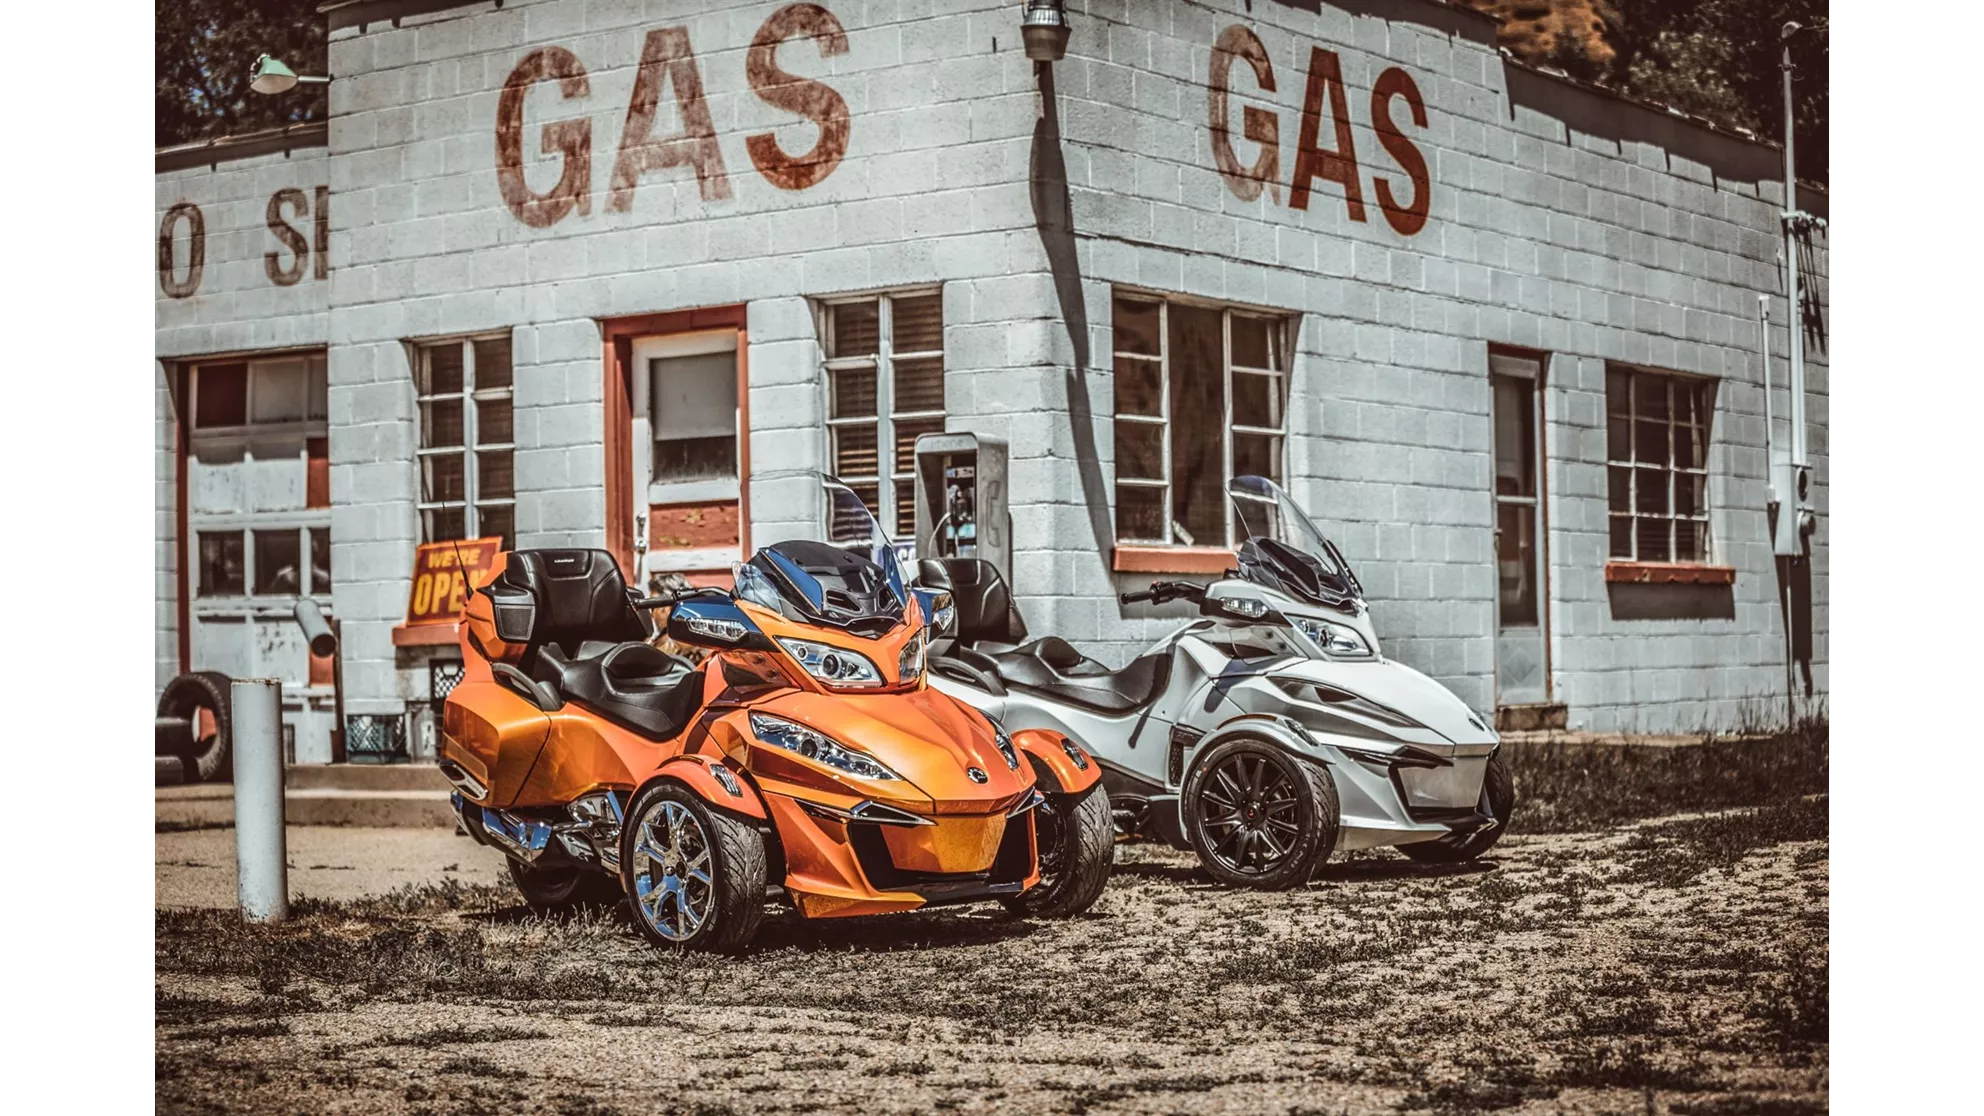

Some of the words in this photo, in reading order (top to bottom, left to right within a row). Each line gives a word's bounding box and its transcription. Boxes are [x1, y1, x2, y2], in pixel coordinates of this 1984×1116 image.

[495, 2, 851, 229] GAS
[1207, 23, 1431, 236] GAS
[159, 203, 205, 298] O
